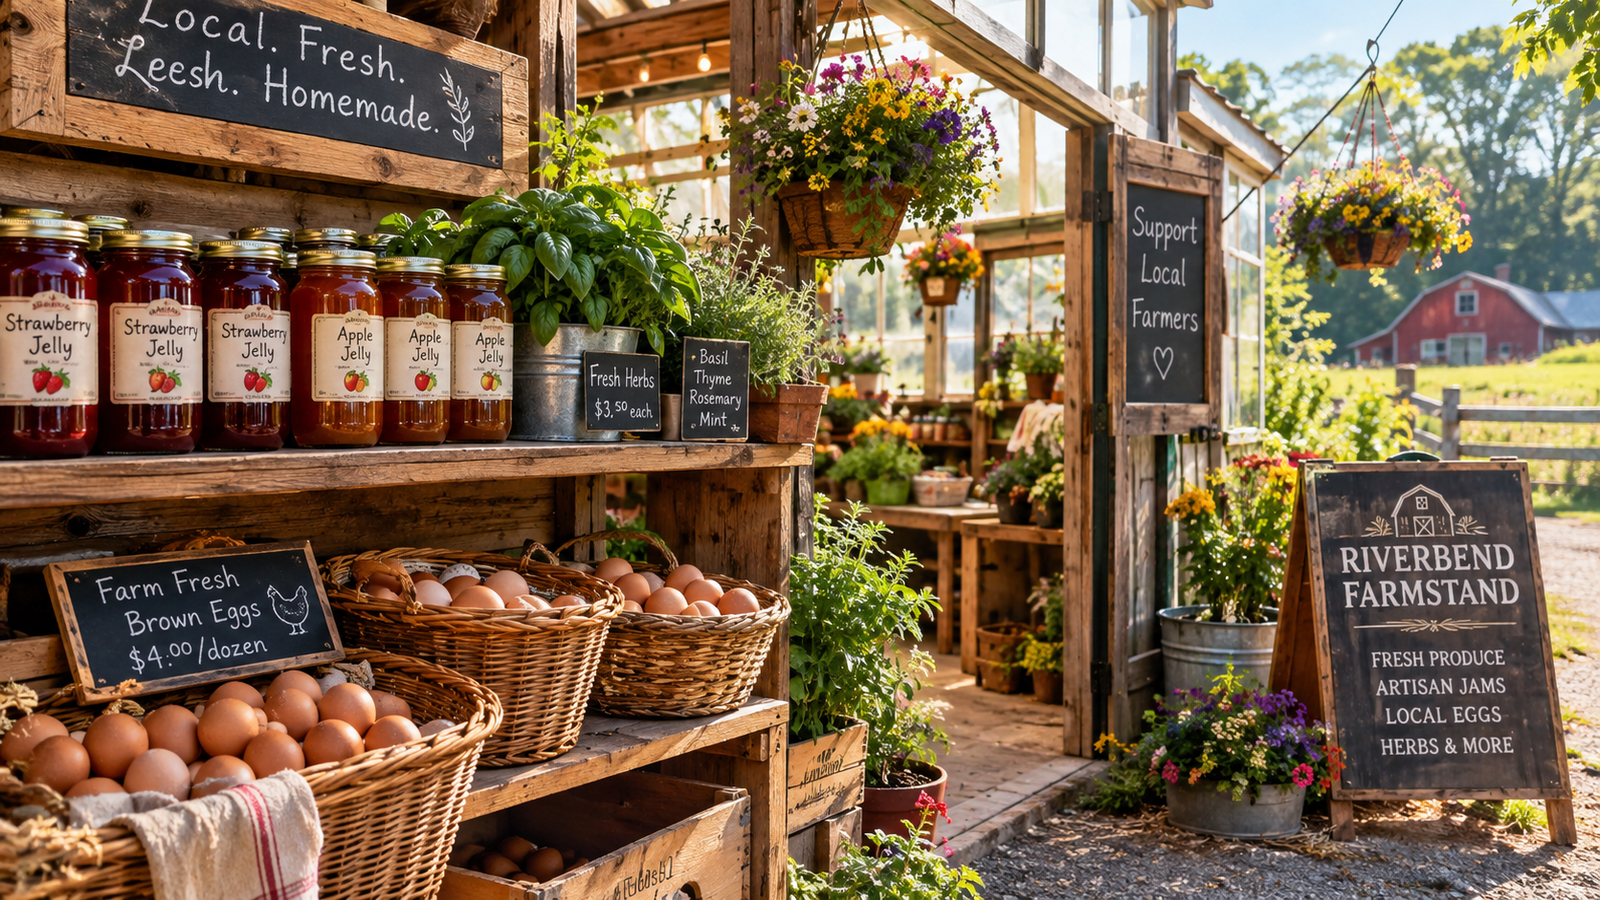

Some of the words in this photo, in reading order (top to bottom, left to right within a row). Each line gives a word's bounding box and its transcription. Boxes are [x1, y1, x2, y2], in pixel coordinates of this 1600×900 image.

[138, 0, 277, 53] Local.
[299, 24, 404, 84] Fresh.
[115, 34, 239, 96] Leesh.
[263, 64, 439, 134] Homemade.
[1132, 205, 1198, 251] Support
[1141, 253, 1186, 287] Local
[5, 313, 91, 337] Strawberry
[1132, 297, 1199, 332] Farmers
[124, 318, 199, 341] Strawberry
[221, 322, 287, 344] Strawberry
[337, 326, 373, 345] Apple
[408, 329, 442, 346] Apple
[475, 332, 505, 349] Apple
[29, 335, 72, 361] Jelly
[146, 339, 183, 363] Jelly
[241, 342, 274, 364] Jelly
[341, 346, 371, 366] Jelly
[412, 347, 439, 367] Jelly
[479, 349, 504, 367] Jelly
[700, 348, 729, 365] Basil
[590, 363, 621, 387] Fresh
[625, 367, 655, 389] Herbs
[693, 369, 732, 390] Thyme
[595, 398, 628, 421] $3.50
[630, 403, 653, 419] each
[689, 389, 742, 411] Rosemary
[699, 411, 727, 427] Mint
[1339, 543, 1515, 574] RIVERBEND
[95, 575, 164, 604] Farm
[171, 565, 240, 595] Fresh
[1342, 578, 1520, 609] FARMSTAND
[124, 610, 203, 637] Brown
[209, 599, 262, 630] Eggs
[1371, 651, 1425, 668] FRESH
[1429, 649, 1506, 667] PRODUCE
[1376, 678, 1454, 696] ARTISAN
[1459, 677, 1506, 695] JAMS
[1385, 706, 1447, 725] LOCAL
[1453, 706, 1502, 723] EGGS
[1380, 737, 1440, 756] HERBS
[1444, 738, 1457, 755] &
[1462, 736, 1514, 754] MORE
